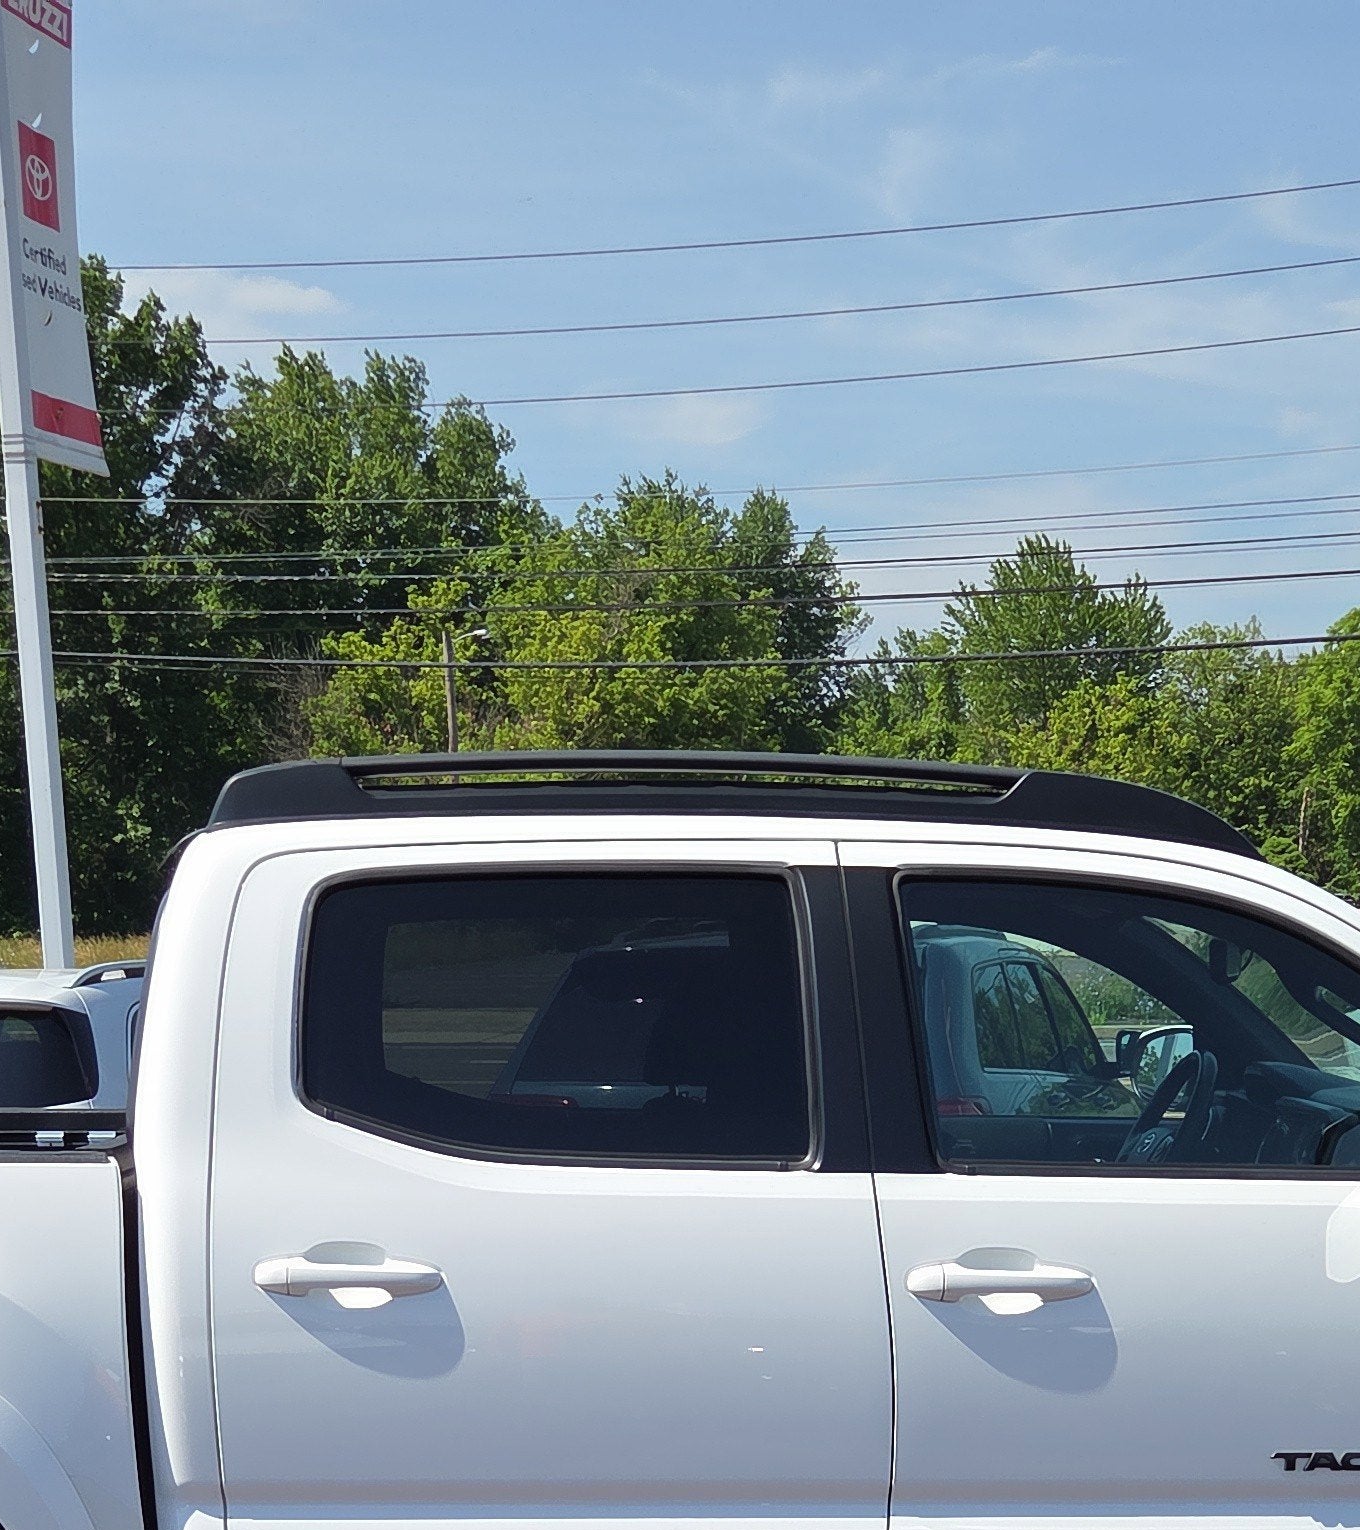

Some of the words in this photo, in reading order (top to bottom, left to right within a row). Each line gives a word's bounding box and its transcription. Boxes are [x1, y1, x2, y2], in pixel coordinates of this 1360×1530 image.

[22, 237, 67, 276] Certified
[21, 272, 37, 294] sed
[37, 275, 82, 313] Vehicles
